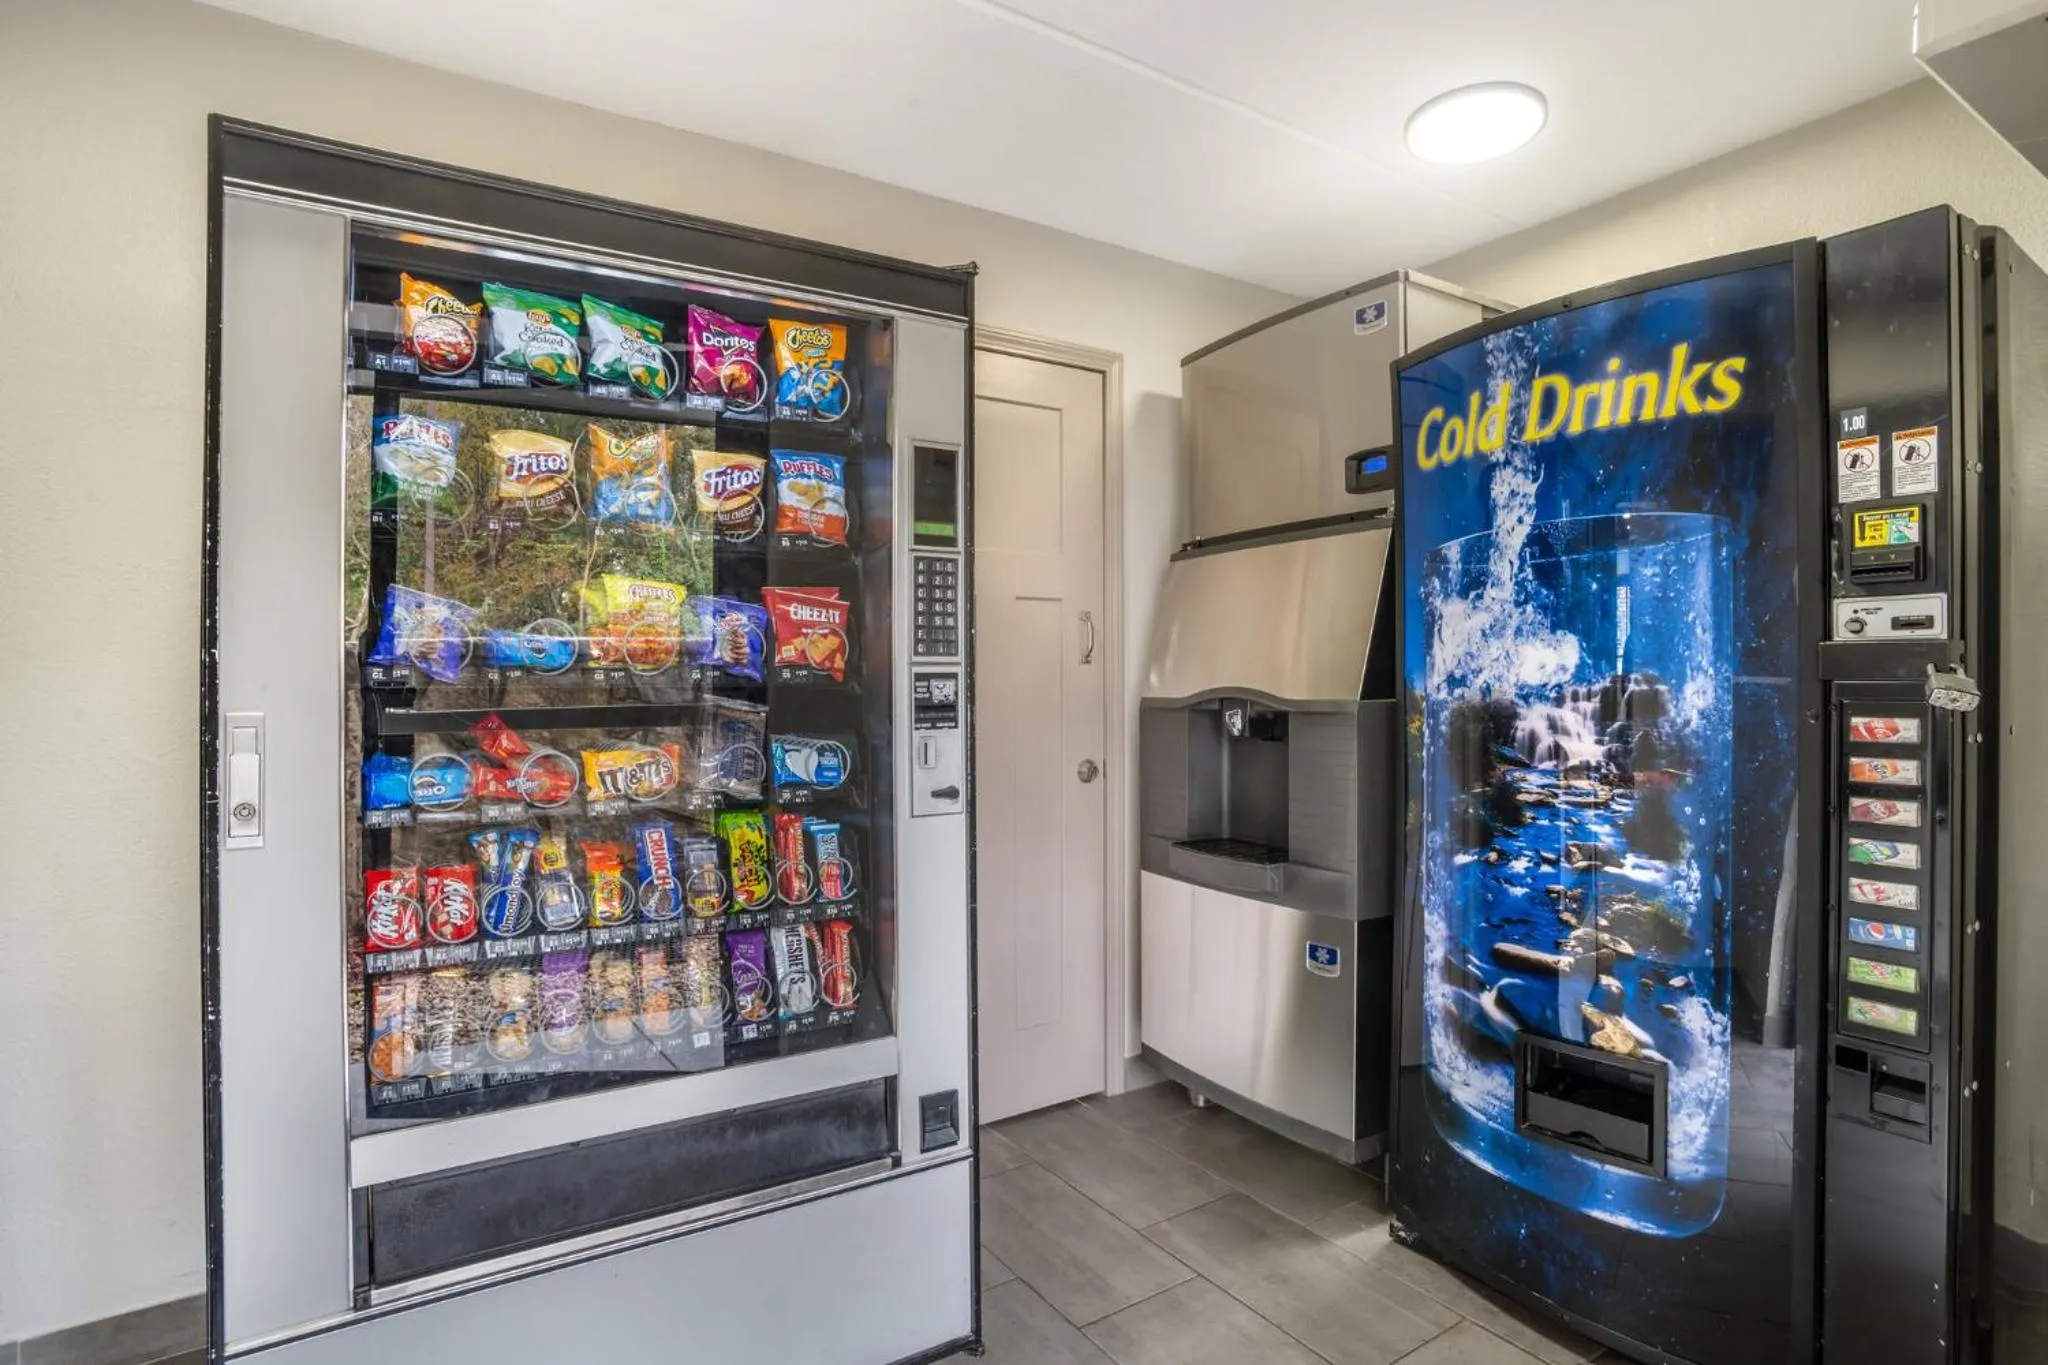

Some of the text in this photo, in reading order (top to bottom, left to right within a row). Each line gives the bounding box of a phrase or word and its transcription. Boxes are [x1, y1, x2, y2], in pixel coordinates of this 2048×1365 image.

[702, 331, 757, 352] Doritos
[785, 327, 832, 350] Cheetos
[1416, 342, 1748, 471] Cold Drinks
[1843, 415, 1865, 432] 1.00
[507, 453, 569, 482] Fritos
[782, 460, 833, 480] RUFFLES
[703, 466, 761, 496] Fritos
[791, 604, 841, 623] CHEEZ-IT
[648, 831, 672, 888] CRUNCH
[785, 923, 806, 985] HERSHEY'S
